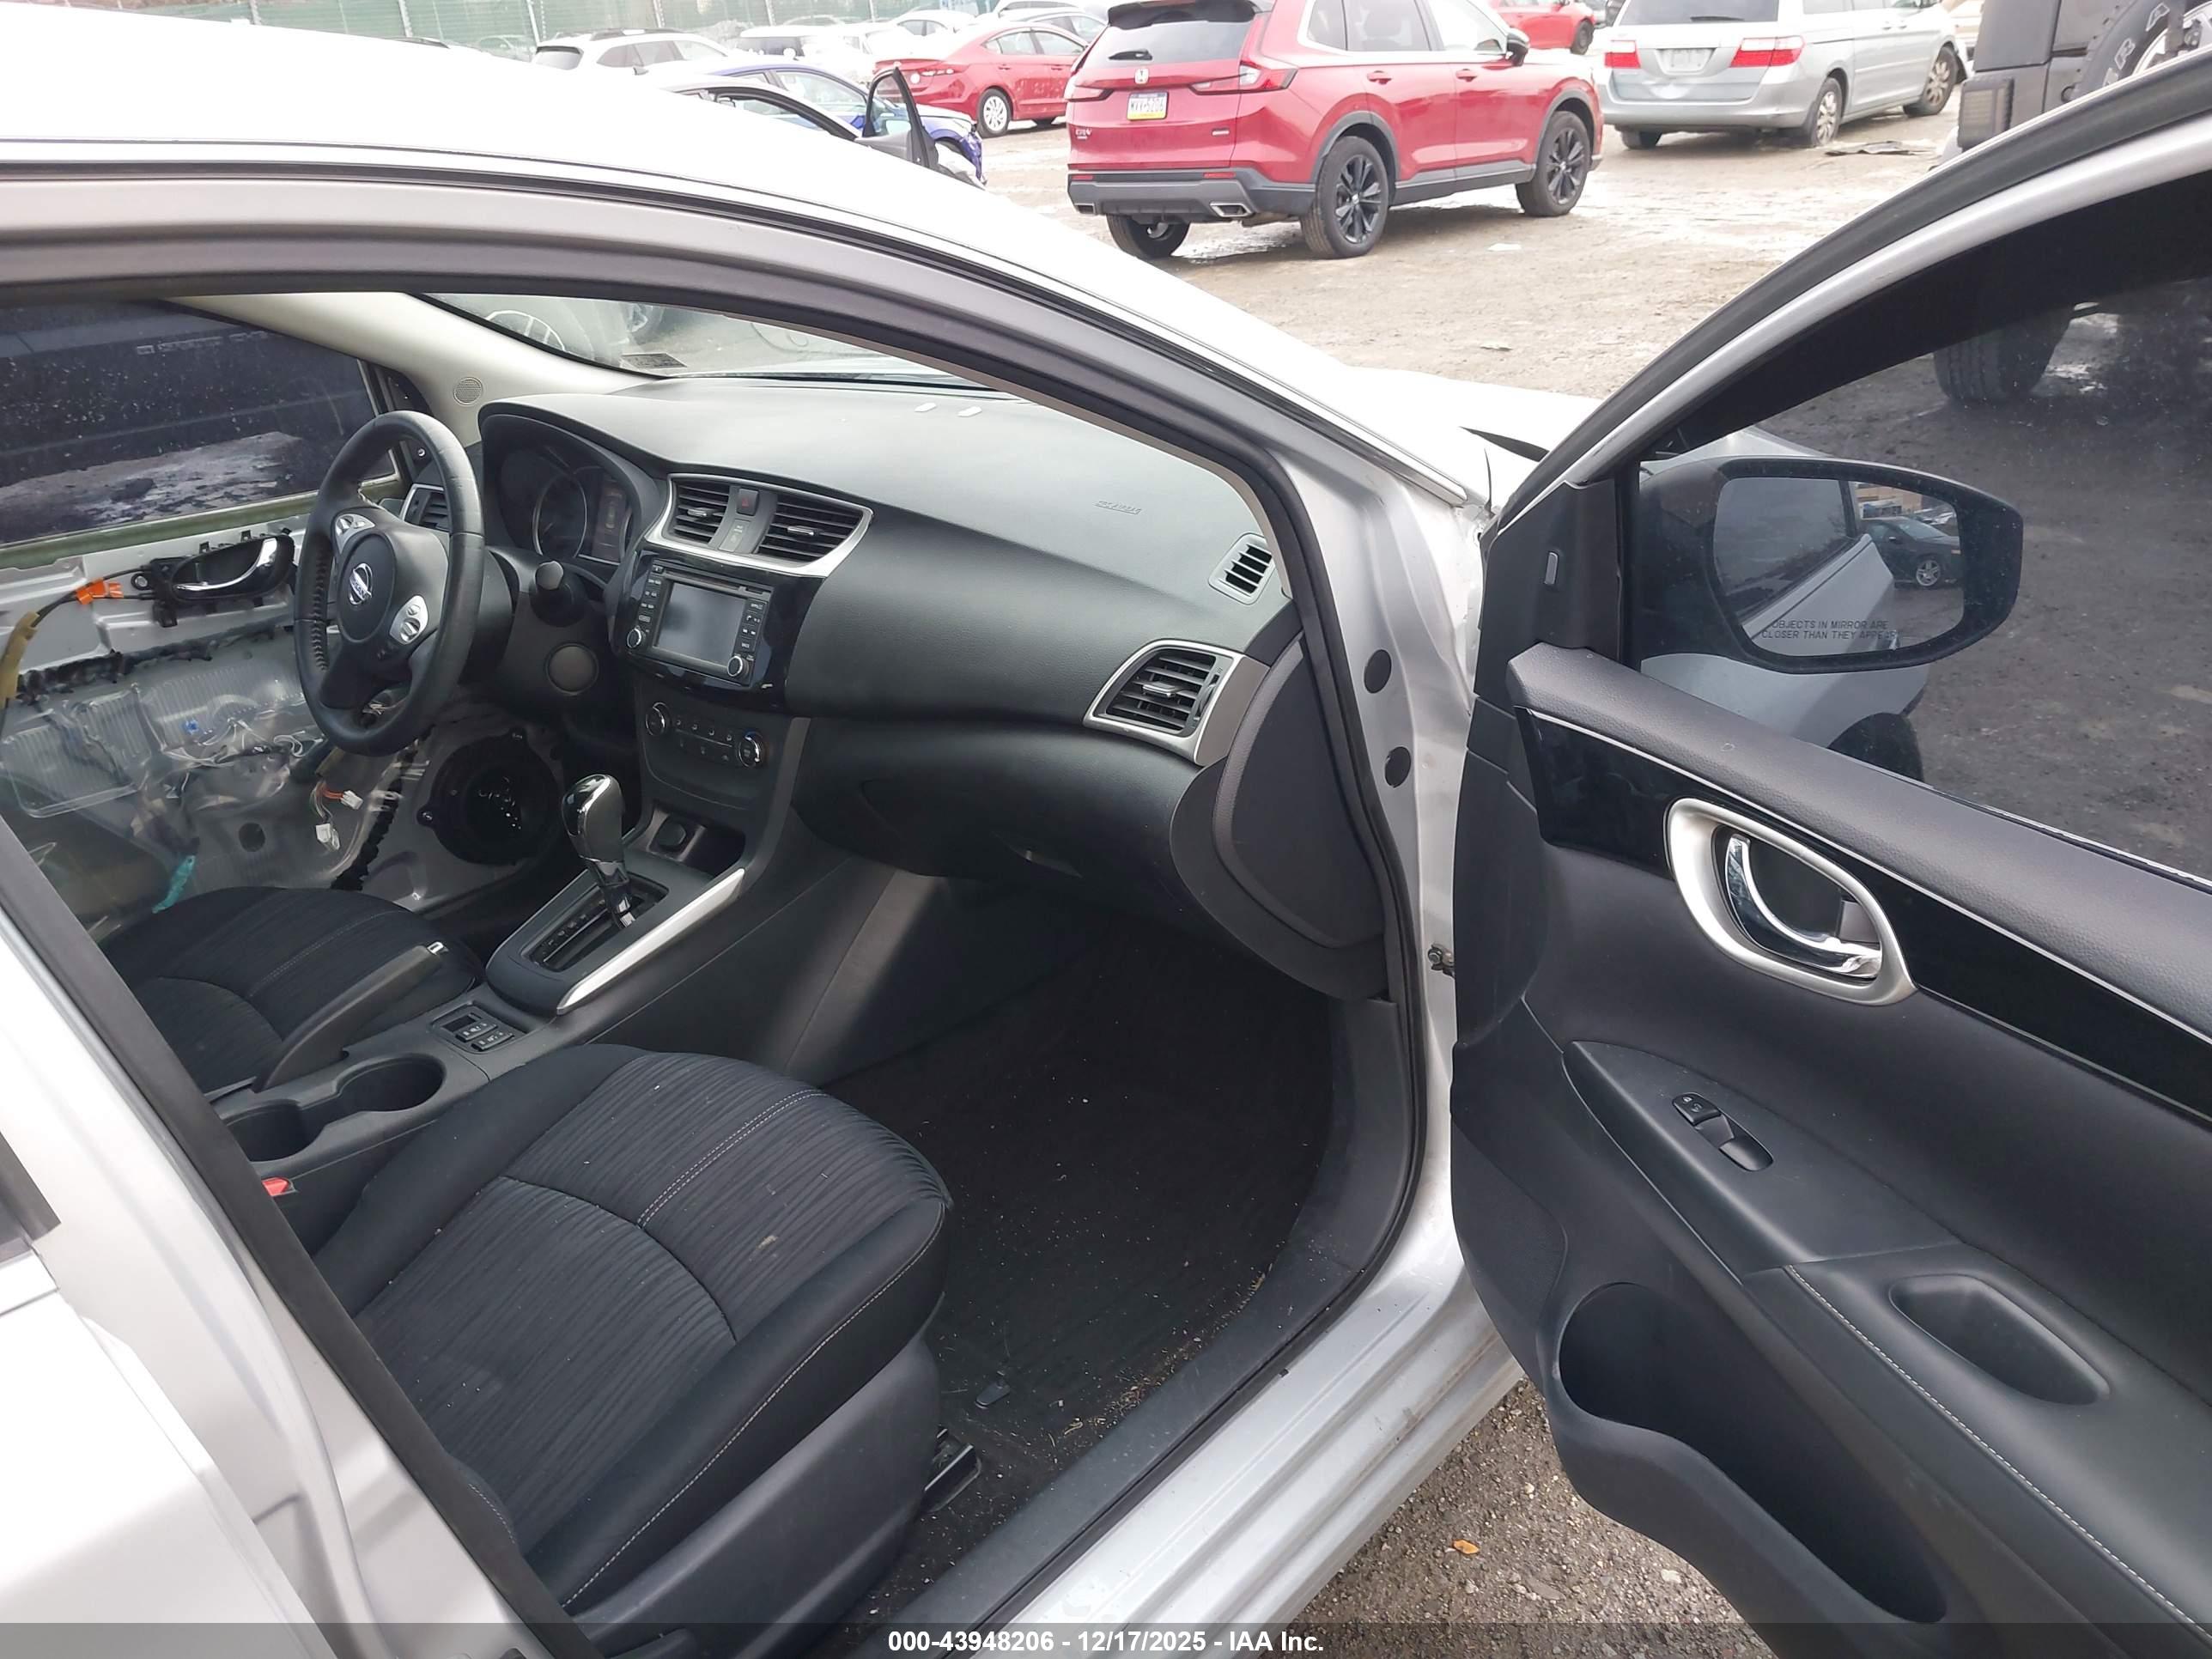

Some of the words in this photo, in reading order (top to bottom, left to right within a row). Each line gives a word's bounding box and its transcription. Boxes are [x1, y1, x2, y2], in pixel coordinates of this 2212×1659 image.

[1772, 620, 1816, 629] OBJECTS
[1818, 620, 1828, 629] IN
[1831, 620, 1868, 629] MIRROR
[1869, 620, 1890, 629] ARE
[1762, 630, 1800, 639] CLOSER
[1803, 630, 1828, 640] THAN
[1832, 630, 1856, 640] THEY
